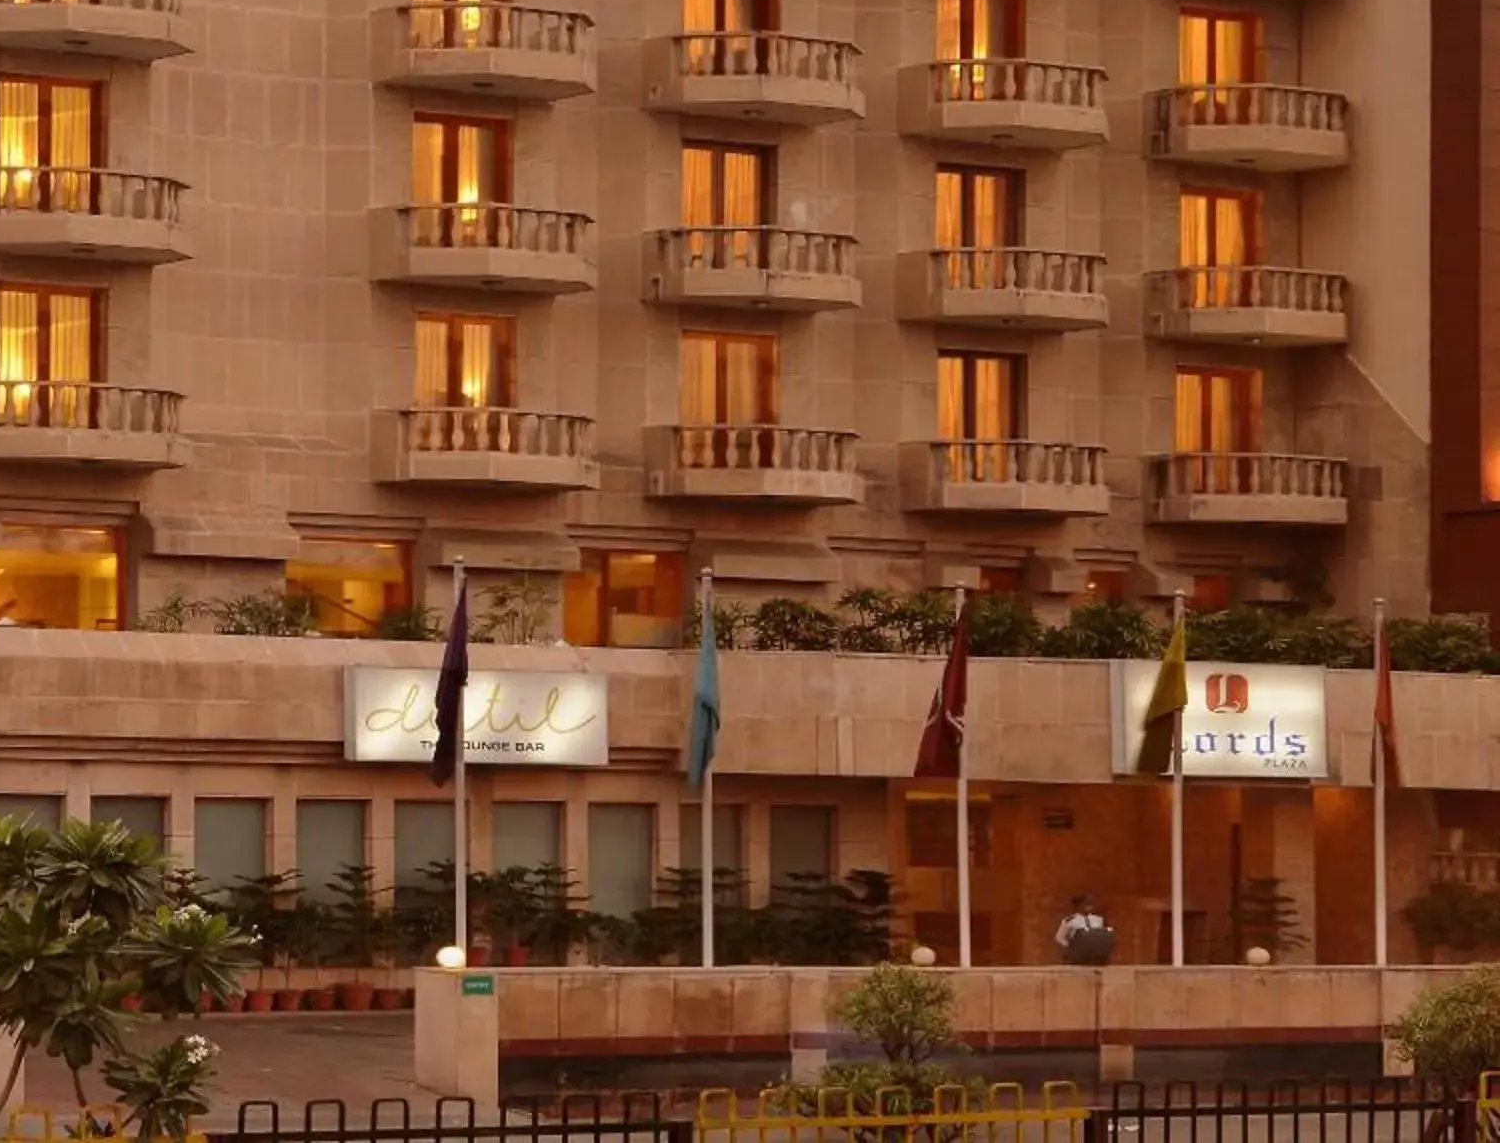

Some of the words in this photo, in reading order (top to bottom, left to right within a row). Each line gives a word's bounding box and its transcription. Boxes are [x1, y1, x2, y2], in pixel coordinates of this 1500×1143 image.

[366, 683, 596, 734] dtil
[461, 740, 511, 751] OUNGE
[515, 742, 545, 752] BAR
[1180, 715, 1307, 755] ords
[1263, 758, 1308, 768] PLAZA
